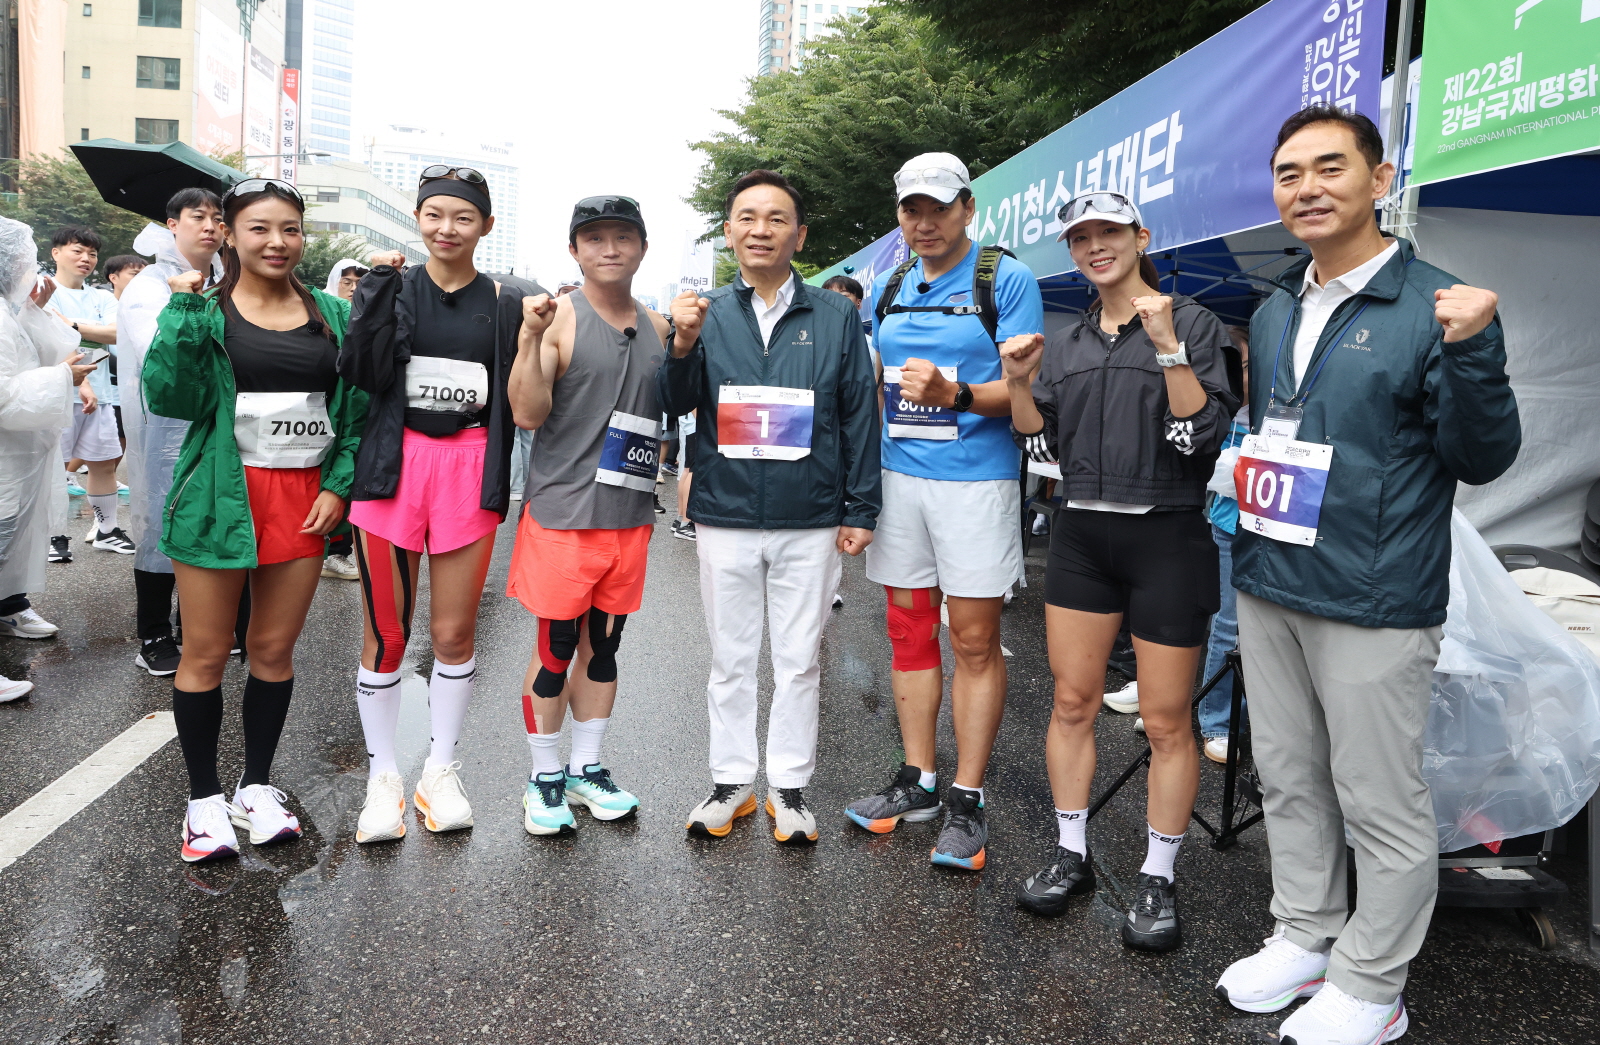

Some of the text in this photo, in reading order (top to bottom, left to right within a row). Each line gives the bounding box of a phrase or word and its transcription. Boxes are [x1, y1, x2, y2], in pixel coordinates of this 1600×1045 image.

[206, 55, 237, 90] 어지럼증
[1442, 52, 1523, 105] 제22회
[213, 79, 230, 105] 센터
[1441, 63, 1599, 137] 강남국제평화
[1437, 141, 1456, 154] 22nd
[1456, 129, 1506, 149] GANGNAM
[1506, 109, 1589, 138] INTERNATIONAL
[282, 119, 295, 180] 광동병원
[480, 143, 510, 155] WESTIN
[418, 384, 478, 404] 71003
[270, 420, 328, 436] 71002
[609, 432, 623, 440] FULL
[756, 410, 770, 438] 1
[1245, 467, 1295, 513] 101
[1150, 831, 1182, 845] cep
